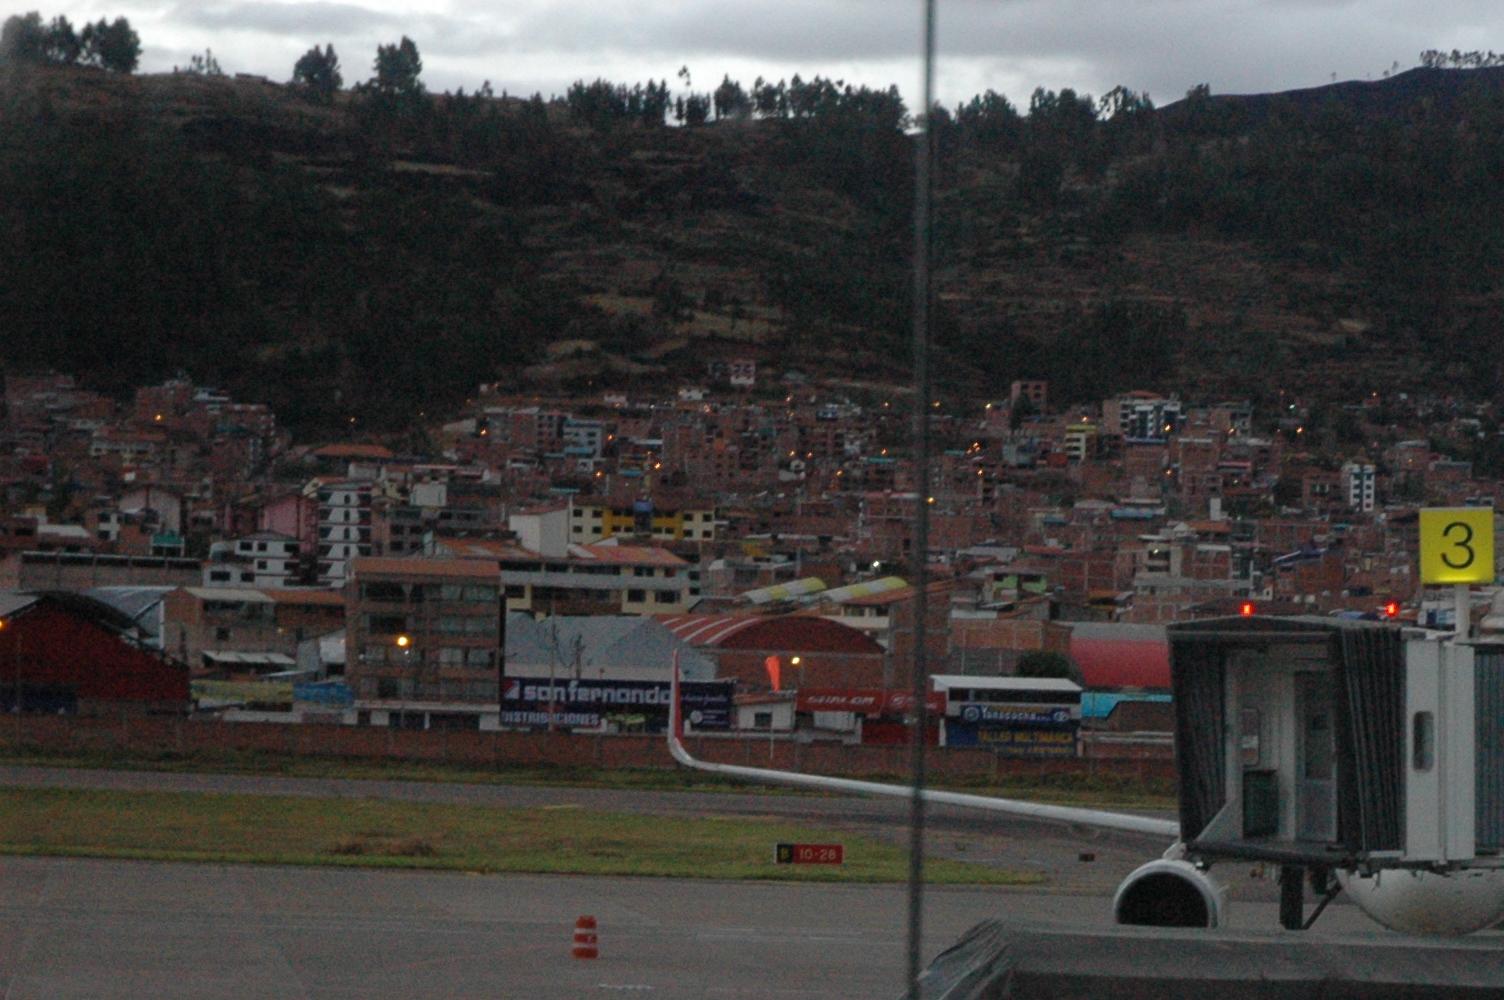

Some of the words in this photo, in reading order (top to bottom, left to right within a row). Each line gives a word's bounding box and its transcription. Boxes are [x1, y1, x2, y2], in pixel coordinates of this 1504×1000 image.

[1440, 521, 1475, 570] 3
[523, 685, 566, 702] san
[567, 680, 671, 705] fernando
